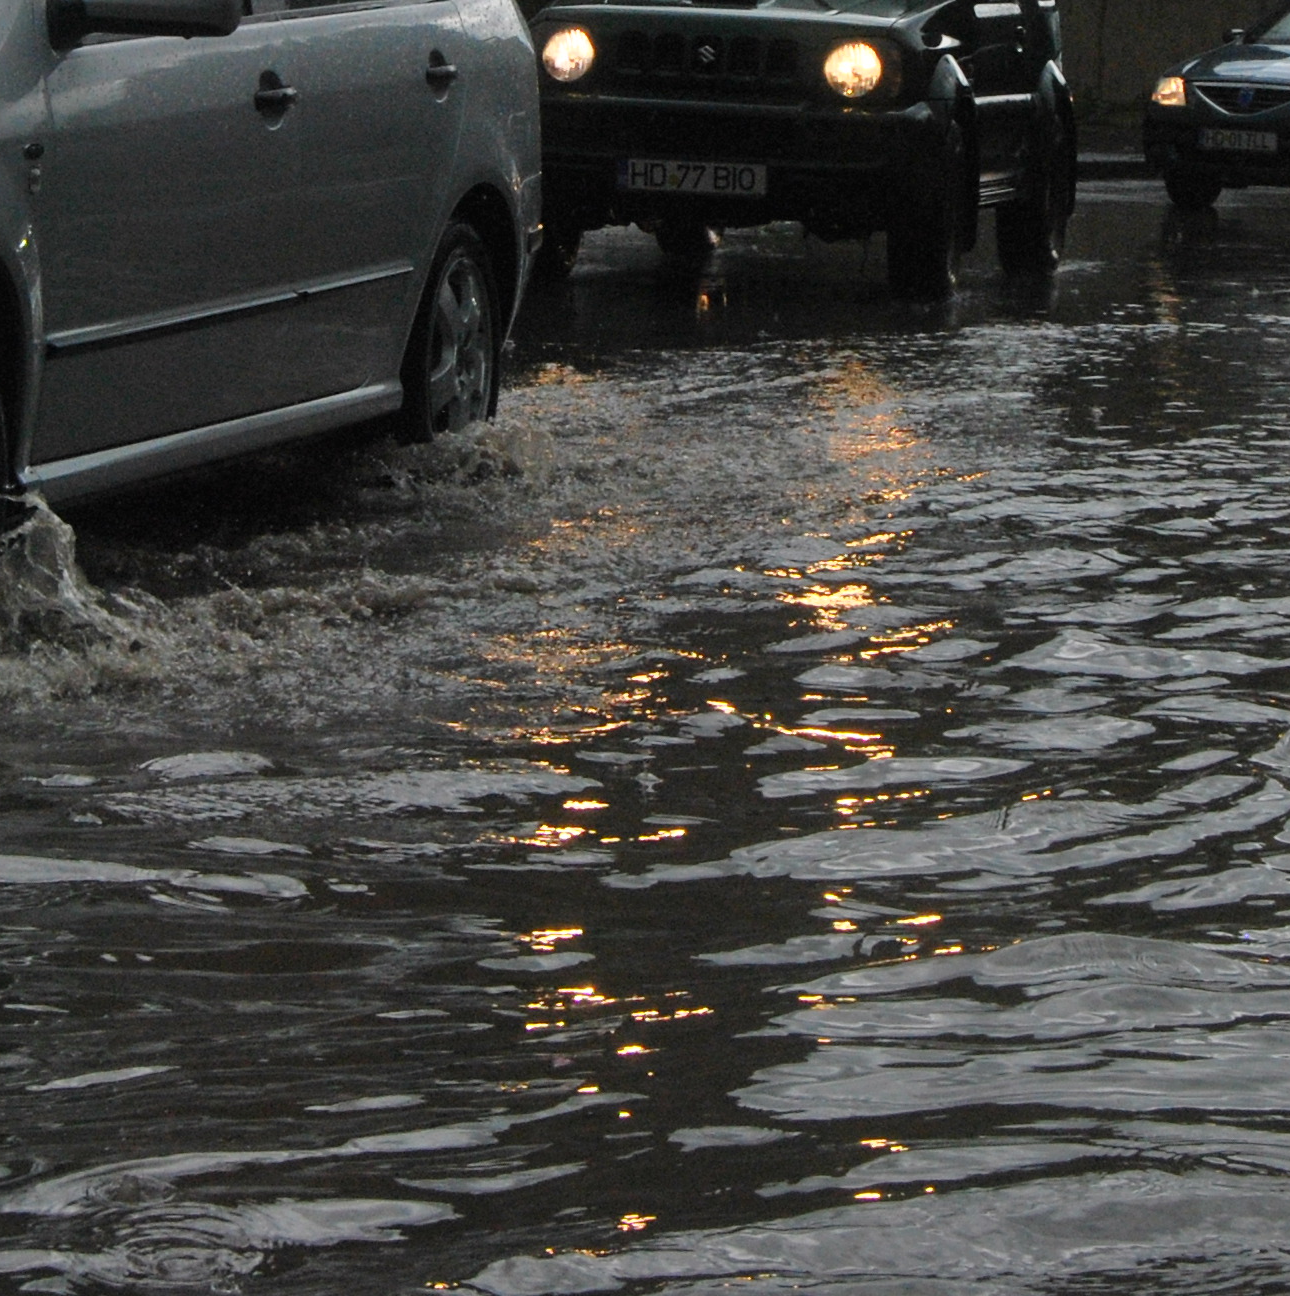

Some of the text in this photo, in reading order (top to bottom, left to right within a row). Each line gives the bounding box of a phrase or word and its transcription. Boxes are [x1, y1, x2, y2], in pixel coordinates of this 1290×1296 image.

[630, 161, 755, 191] HD 77 BIO
